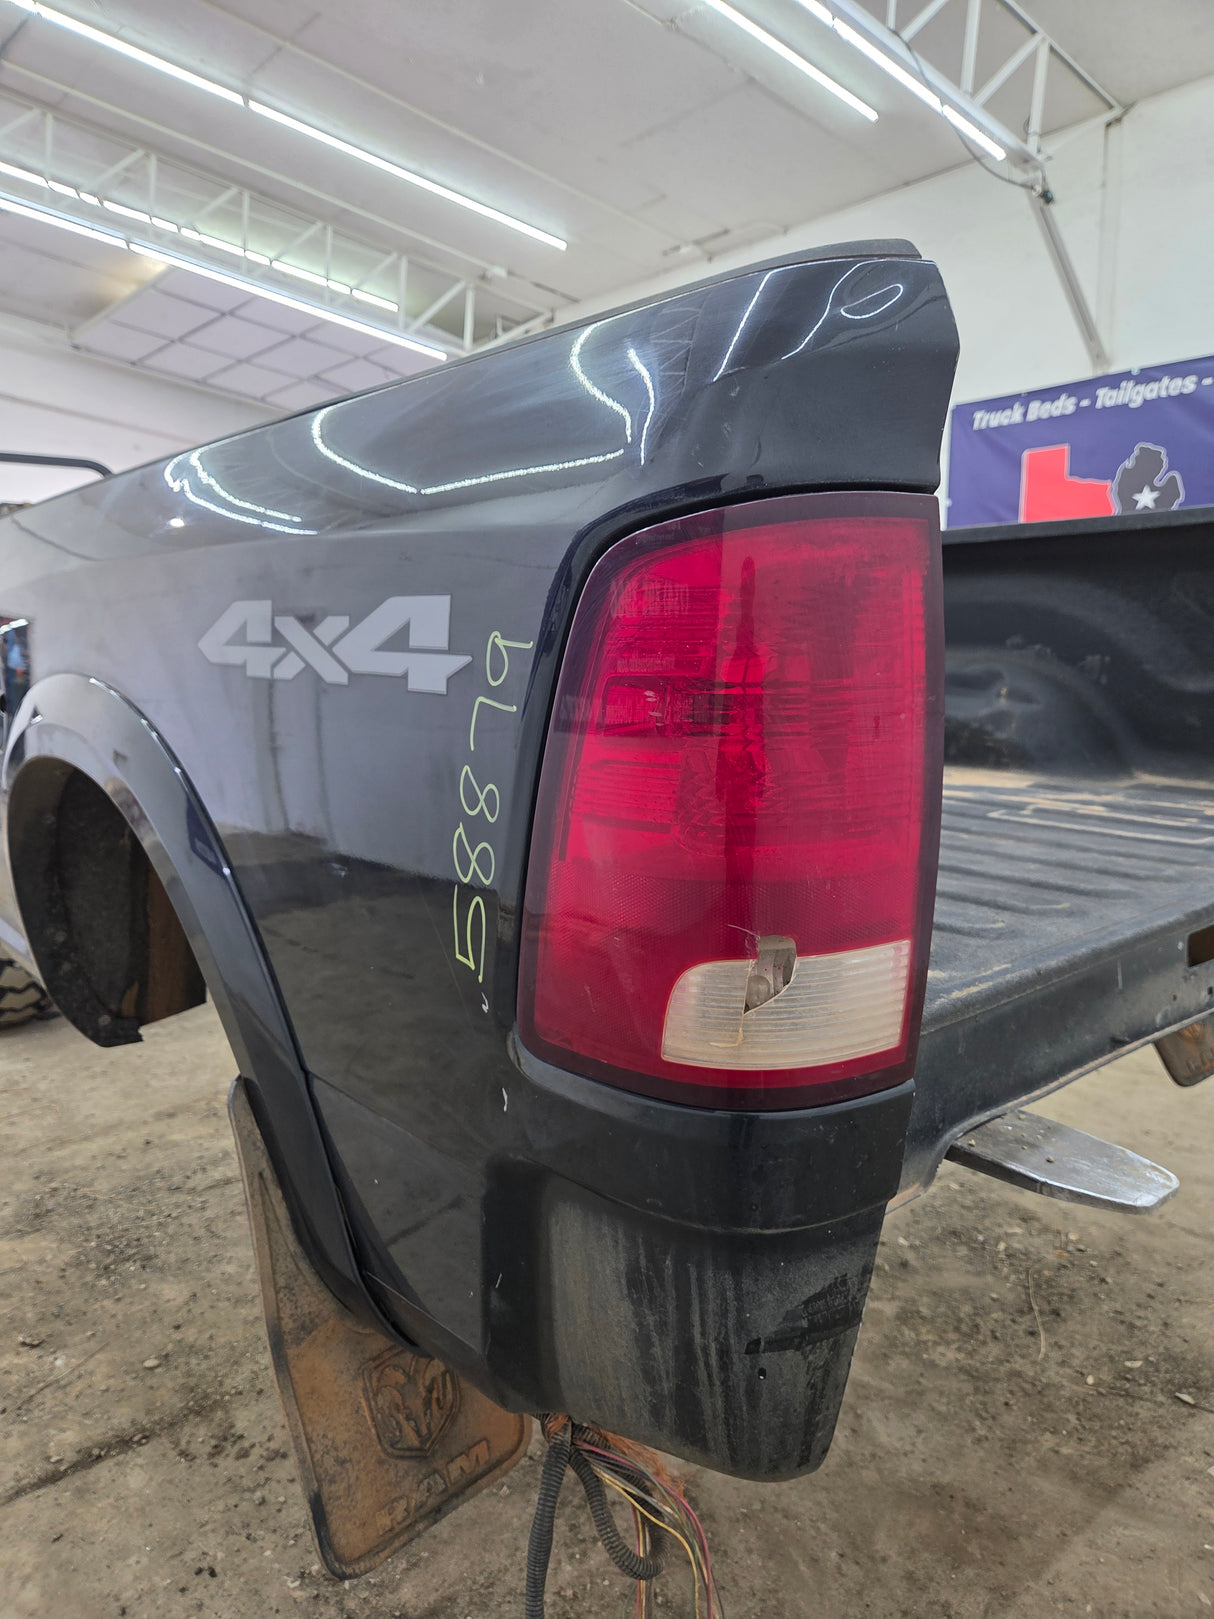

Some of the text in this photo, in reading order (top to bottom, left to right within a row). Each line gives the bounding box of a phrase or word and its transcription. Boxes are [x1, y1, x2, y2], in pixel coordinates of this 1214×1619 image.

[973, 402, 1024, 431] Truck
[1026, 393, 1078, 422] Beds
[1095, 374, 1198, 409] Tailgates
[453, 631, 534, 983] 58879
[375, 1439, 490, 1536] RAM
